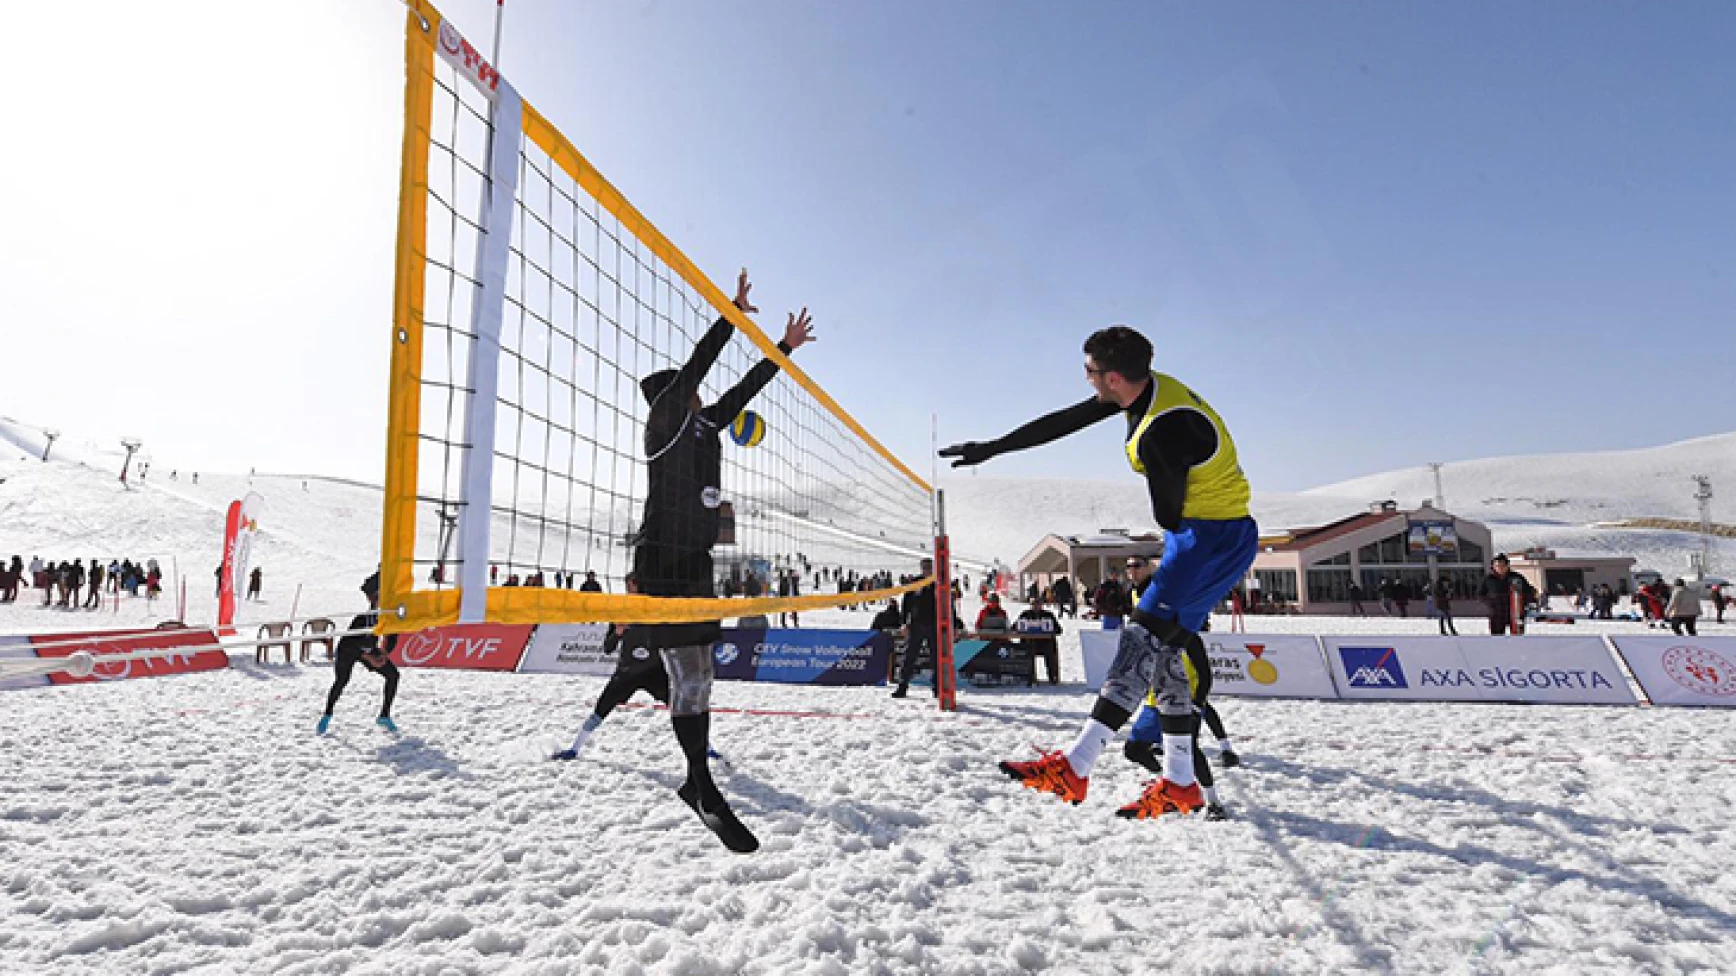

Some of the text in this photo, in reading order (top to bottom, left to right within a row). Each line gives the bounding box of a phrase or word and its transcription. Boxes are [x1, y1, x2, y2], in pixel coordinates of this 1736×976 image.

[446, 638, 503, 660] TVF
[754, 643, 780, 653] CEV
[815, 645, 874, 657] Volleyball
[751, 655, 866, 670] European Tour 2022
[1349, 666, 1396, 685] AXA
[1420, 666, 1613, 689] AXA SİGORTA
